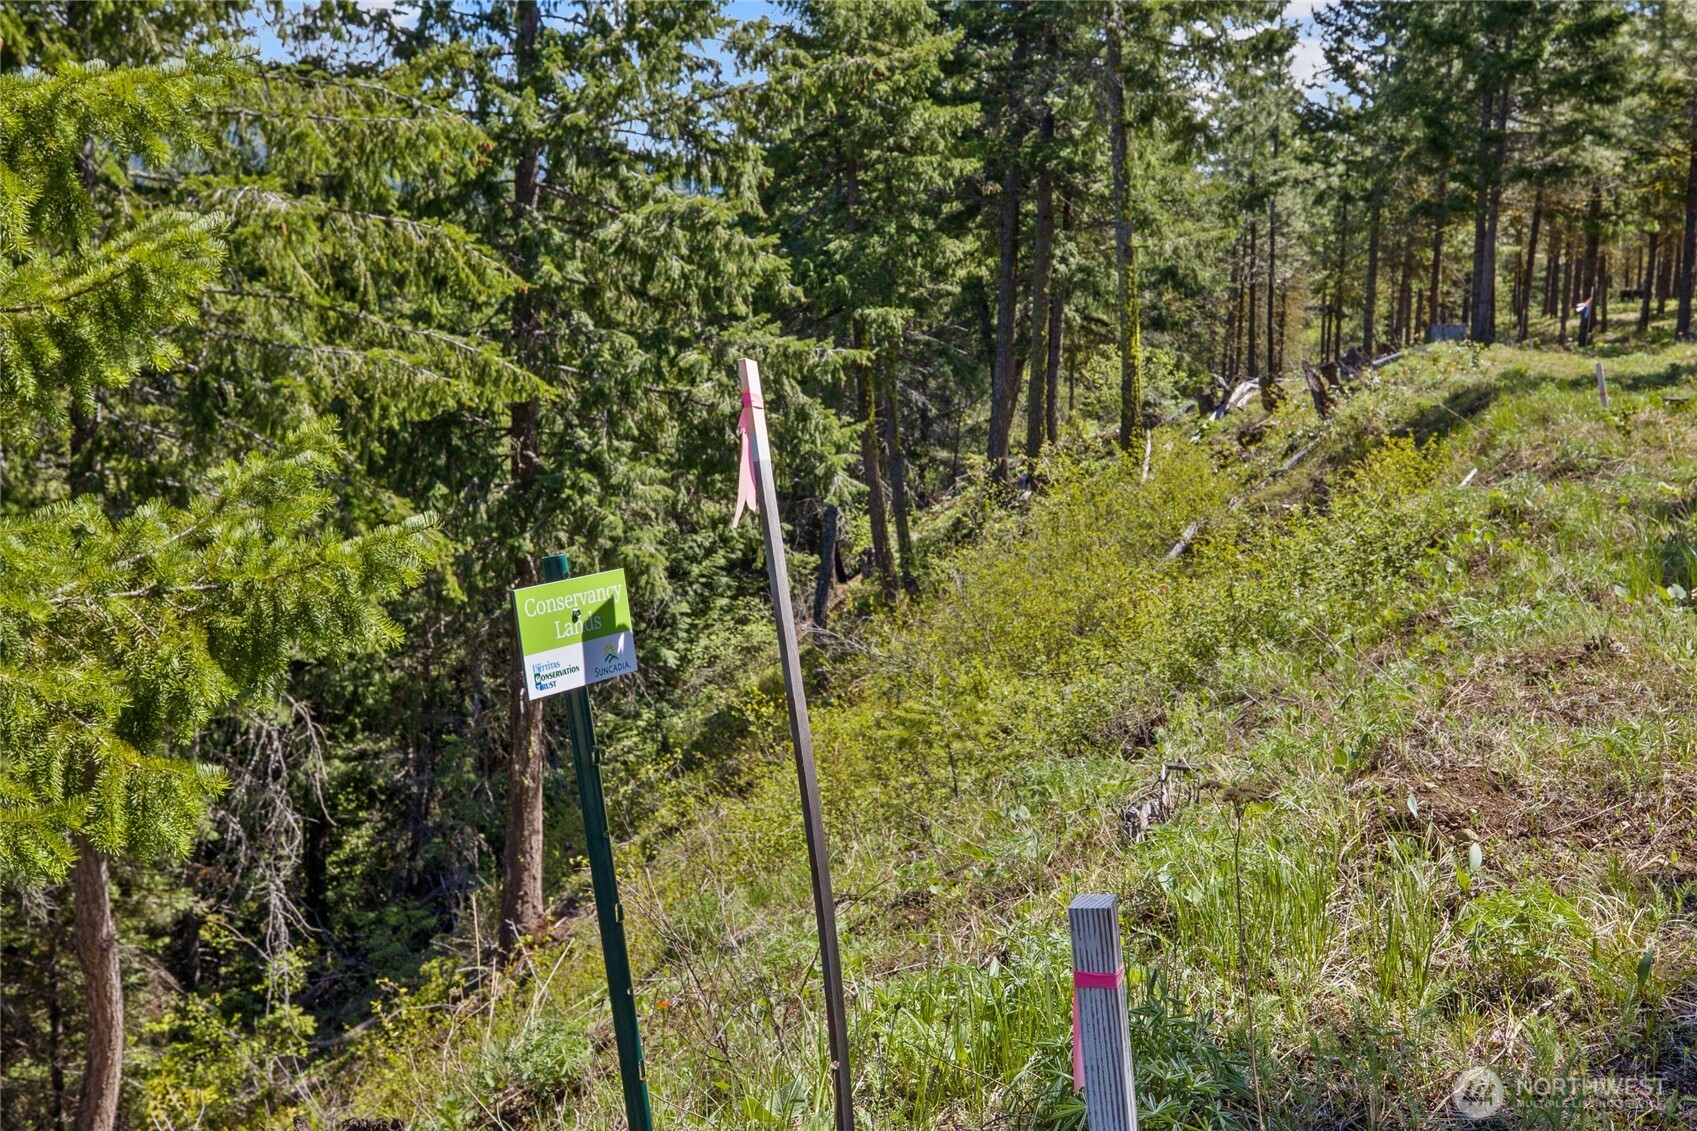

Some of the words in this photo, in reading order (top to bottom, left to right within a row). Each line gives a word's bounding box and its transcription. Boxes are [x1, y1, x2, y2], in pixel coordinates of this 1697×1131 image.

[524, 583, 622, 618] Conservancy
[554, 611, 602, 639] Lands
[535, 681, 557, 691] TRUST
